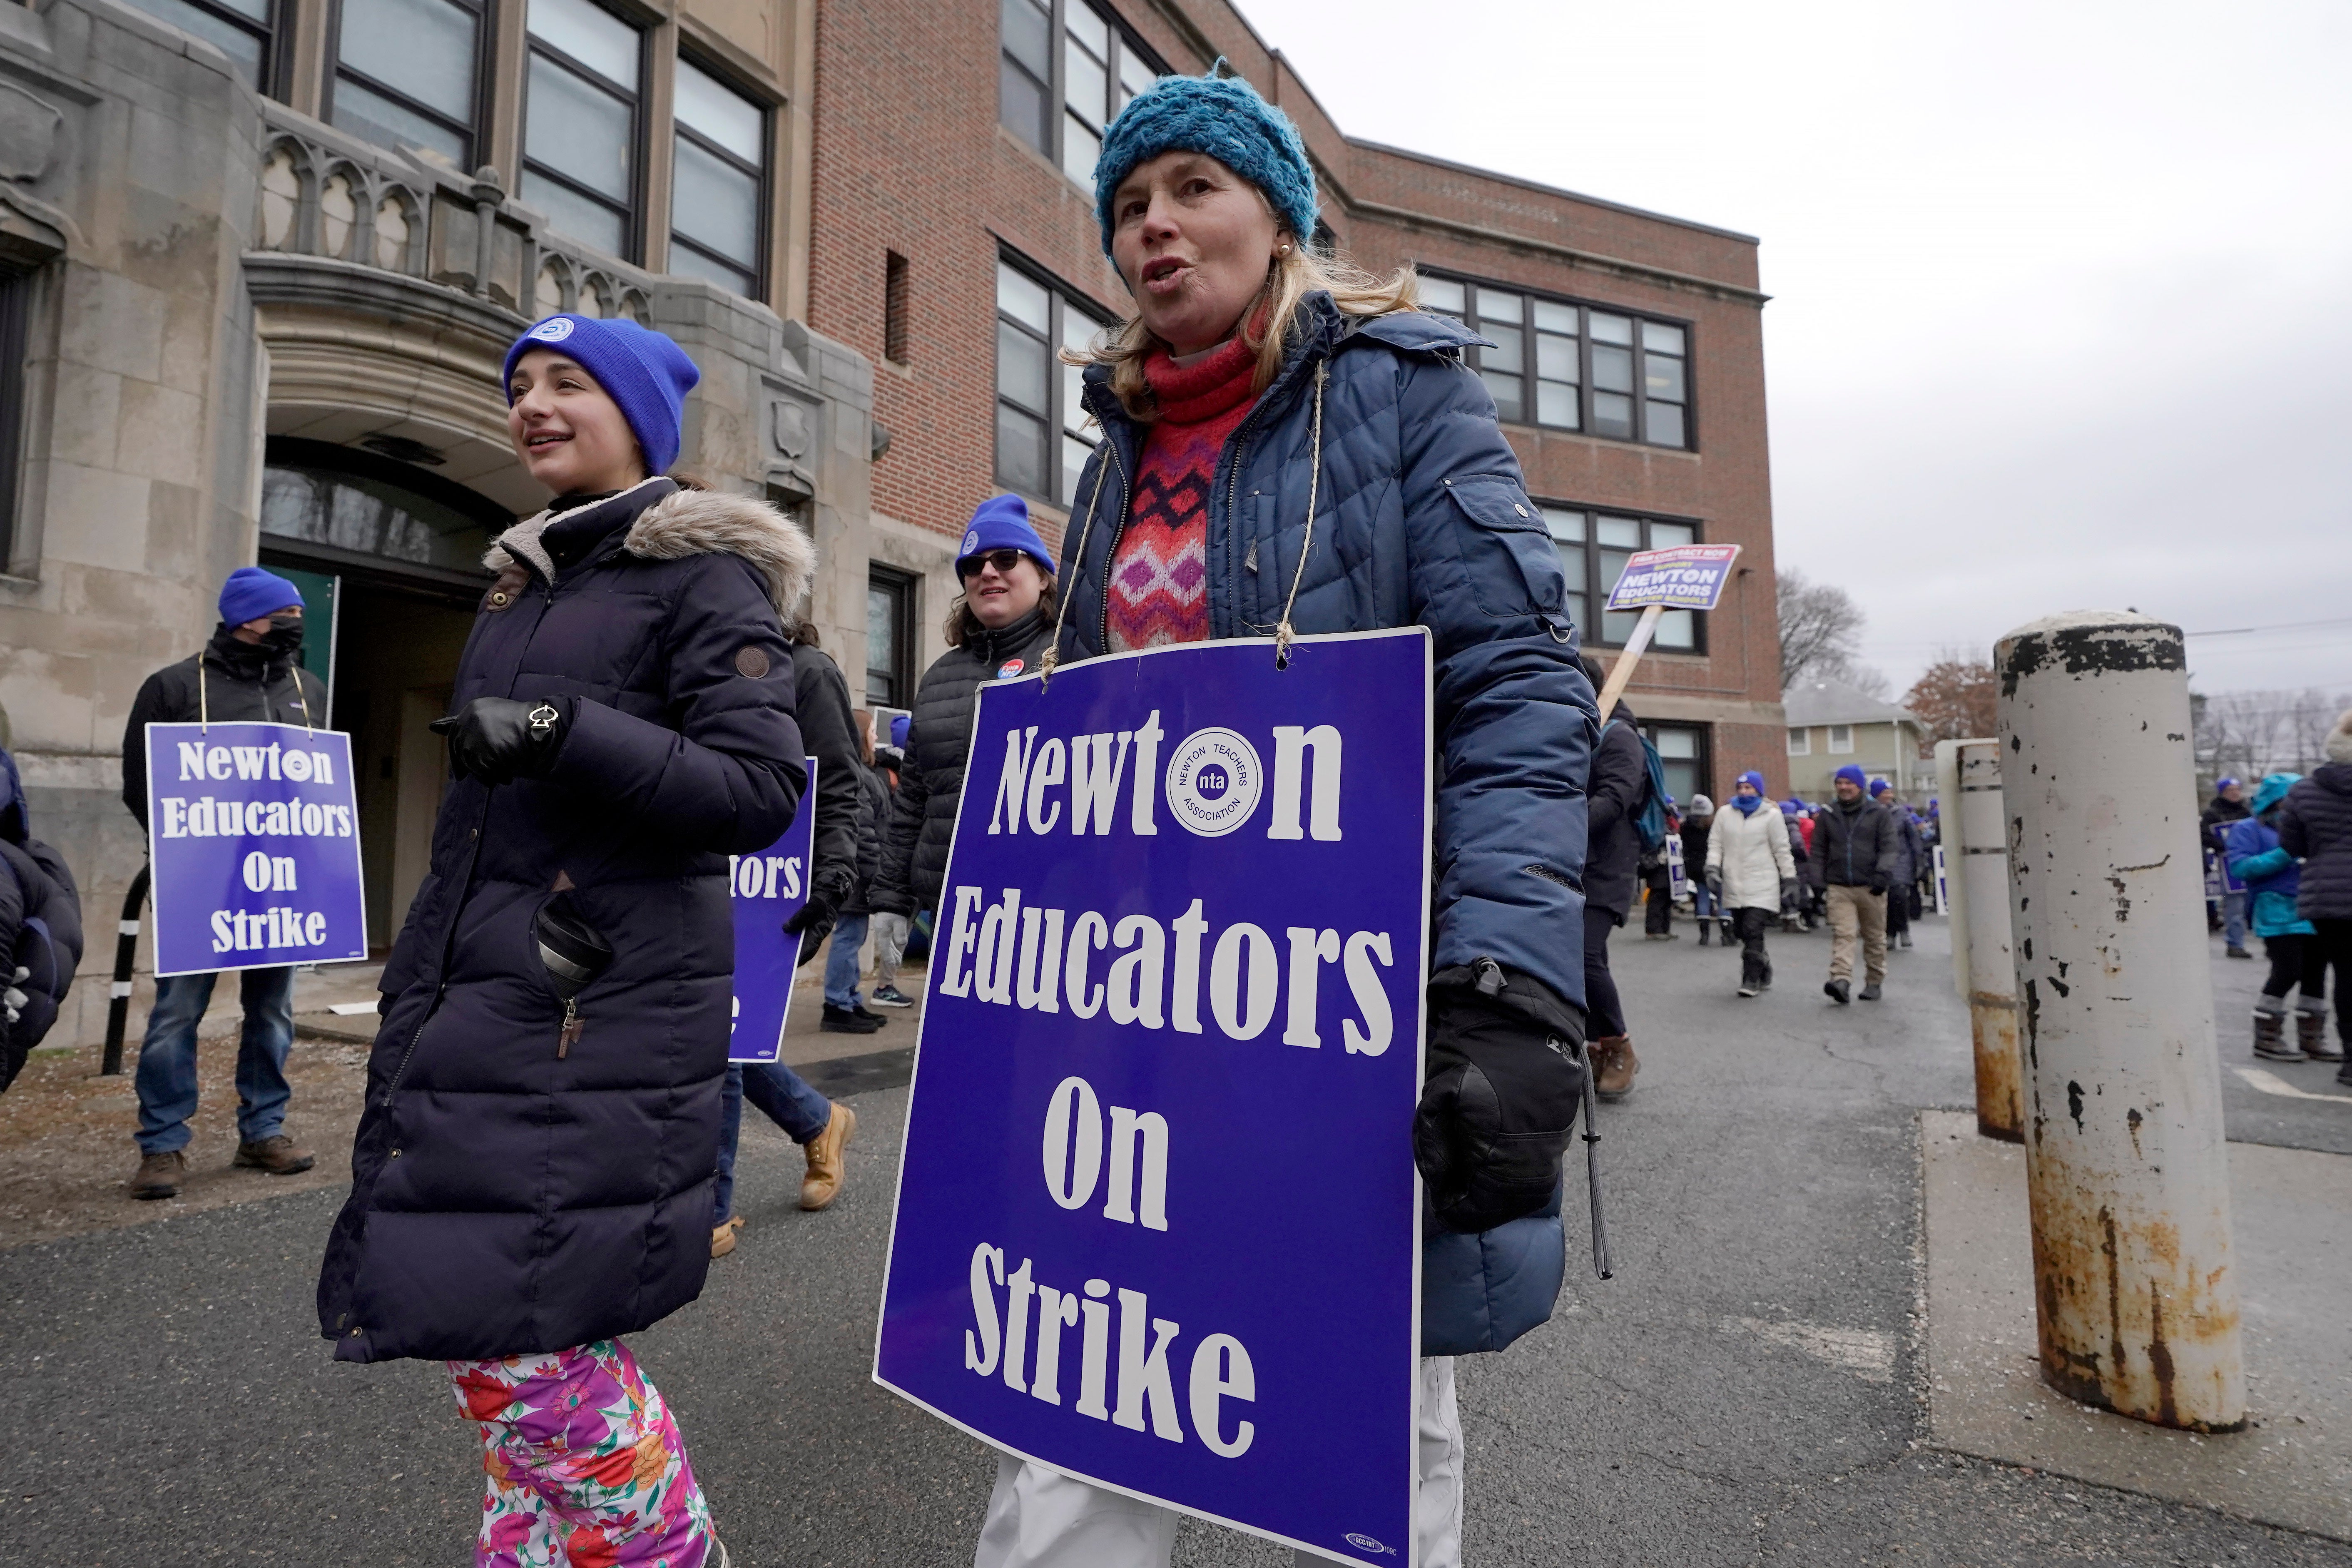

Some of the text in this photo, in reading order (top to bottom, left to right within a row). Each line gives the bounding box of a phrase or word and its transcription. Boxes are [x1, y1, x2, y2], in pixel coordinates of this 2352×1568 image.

[1616, 583, 1712, 599] EDUCATORS
[1621, 569, 1719, 588] NEWTON
[177, 742, 334, 784] Newton
[988, 709, 1342, 841] Newton
[1179, 744, 1247, 786] NEWTON TEACHERS
[1200, 772, 1225, 789] nta
[160, 796, 352, 838] Educators
[1184, 798, 1240, 820] ASSOCIATION
[243, 851, 297, 892] On
[210, 907, 327, 953] Strike
[939, 886, 1394, 1057] Educators
[1043, 1076, 1169, 1232] On
[965, 1242, 1255, 1458] Strike
